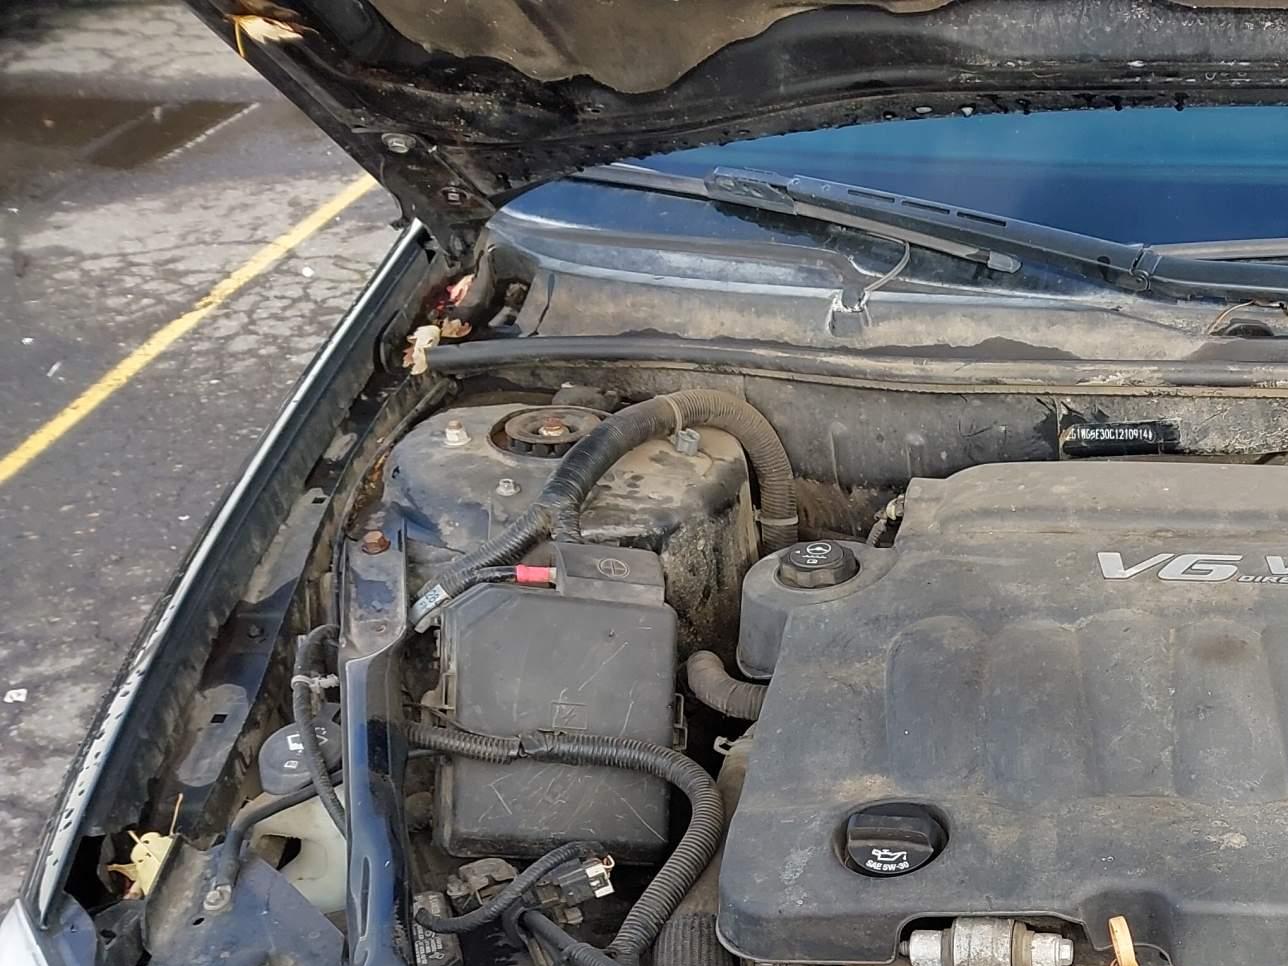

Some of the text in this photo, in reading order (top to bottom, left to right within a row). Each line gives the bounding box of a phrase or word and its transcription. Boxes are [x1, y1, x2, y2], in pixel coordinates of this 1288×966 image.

[1097, 552, 1244, 583] V6
[865, 859, 910, 871] SAE 5W-30
